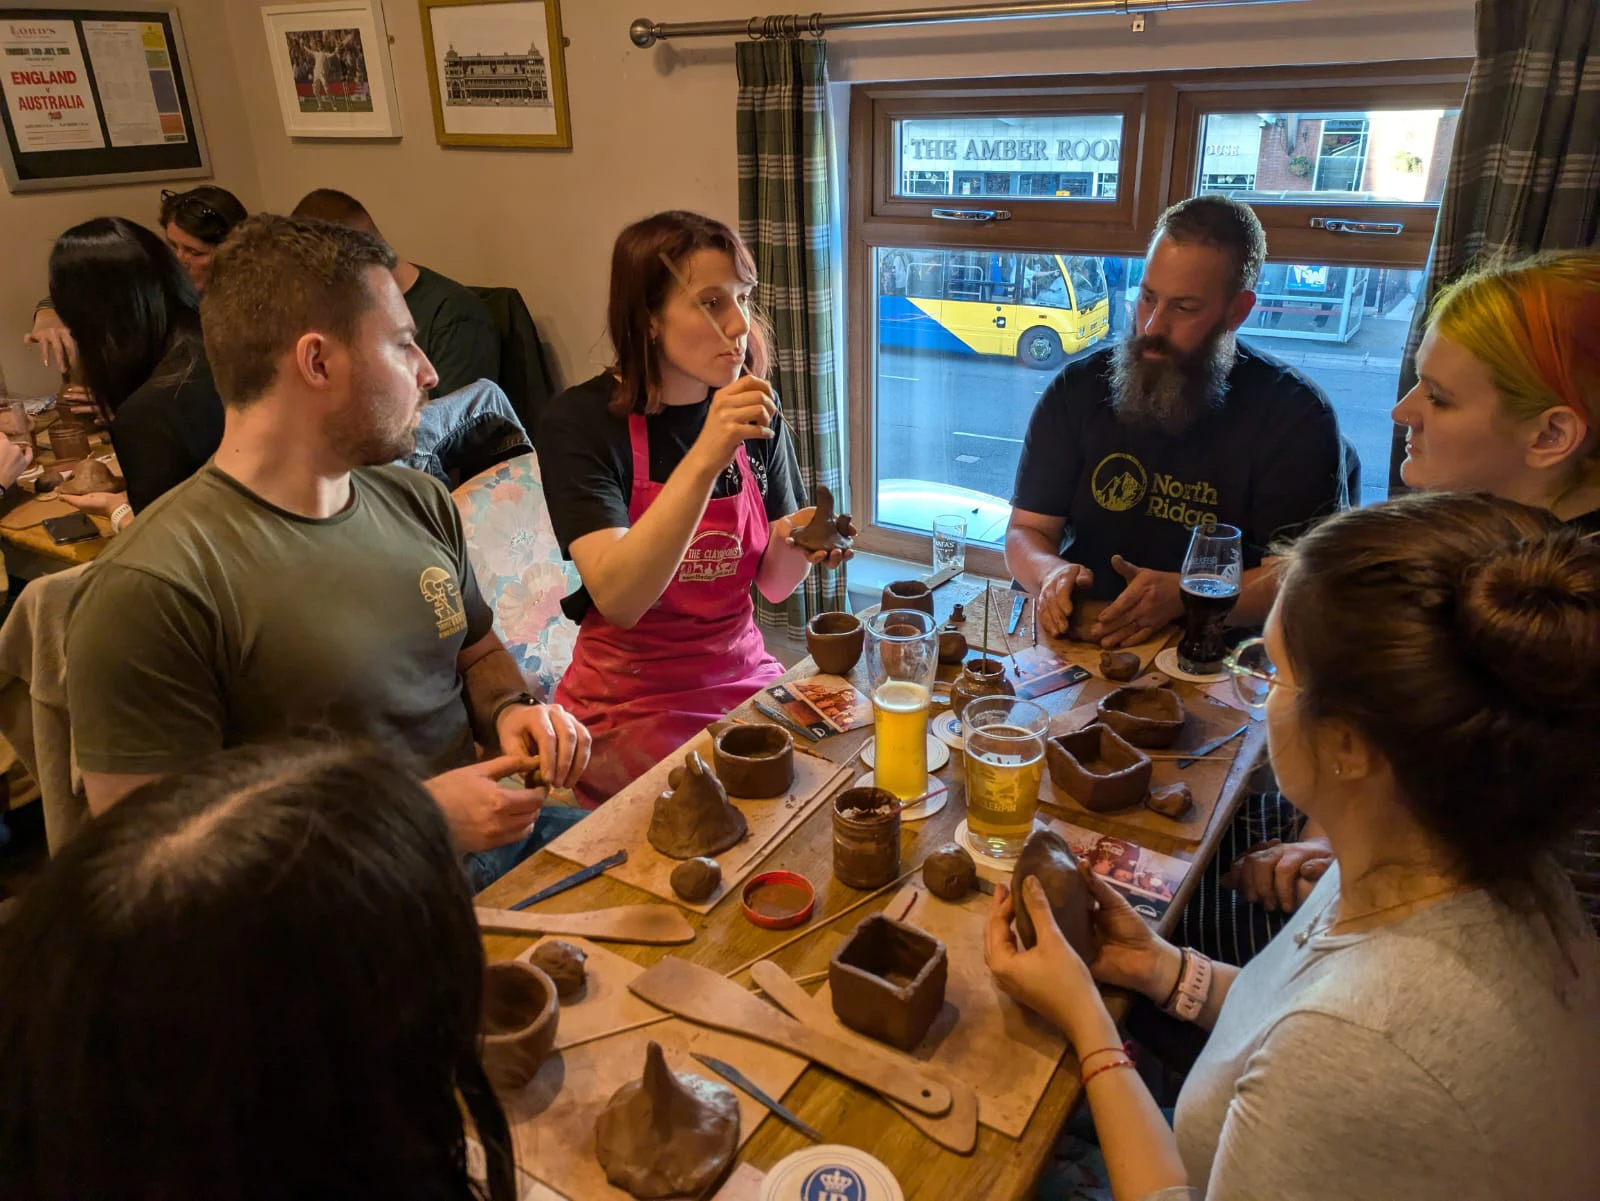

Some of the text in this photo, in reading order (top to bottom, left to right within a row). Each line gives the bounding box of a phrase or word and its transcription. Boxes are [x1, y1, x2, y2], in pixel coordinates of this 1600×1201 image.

[11, 70, 77, 85] ENGLAND
[18, 95, 85, 111] AUSTRALIA
[910, 138, 957, 161] THE
[963, 138, 1049, 161] AMBER
[1150, 472, 1218, 506] North
[1145, 495, 1218, 531] Ridge
[688, 549, 701, 559] THE
